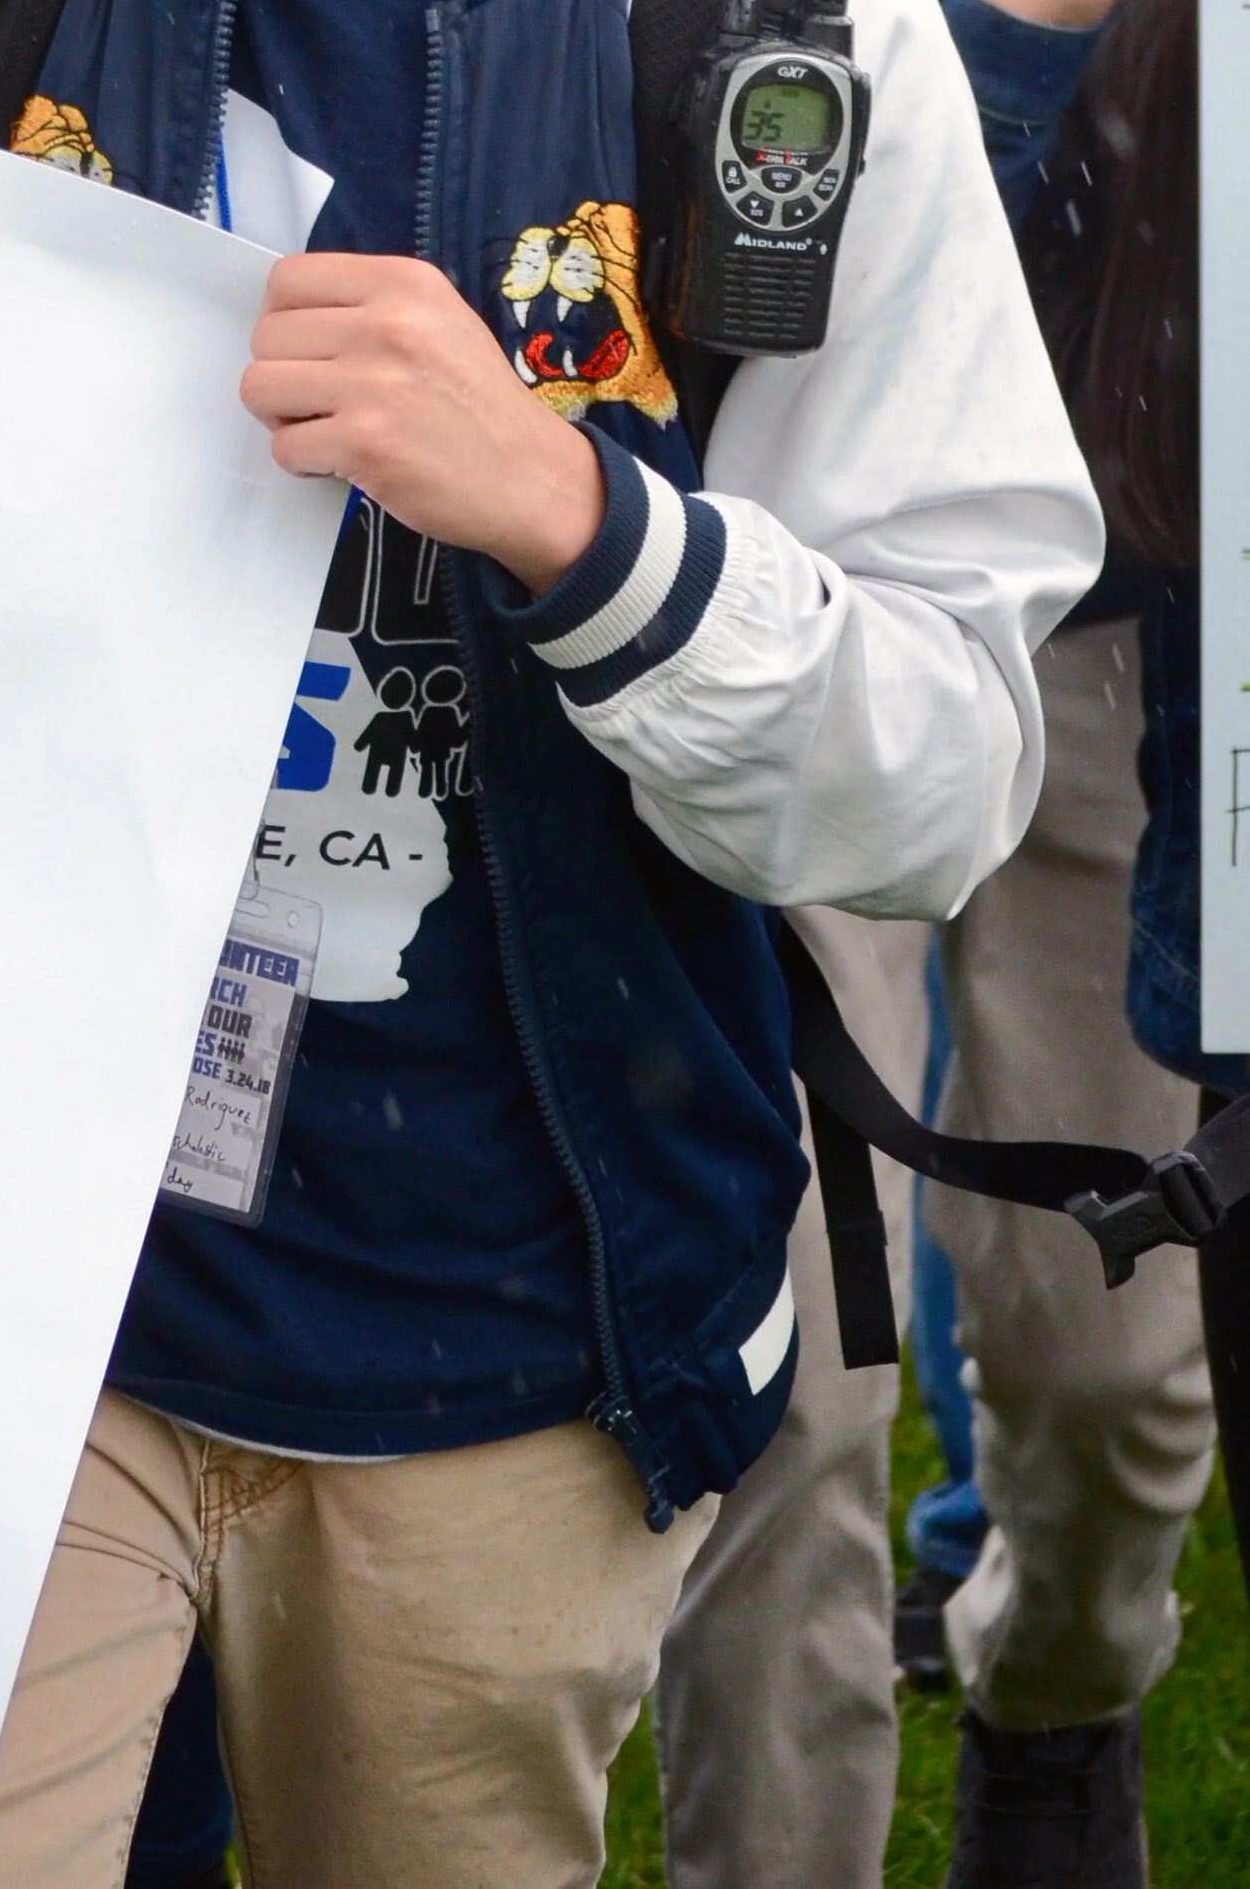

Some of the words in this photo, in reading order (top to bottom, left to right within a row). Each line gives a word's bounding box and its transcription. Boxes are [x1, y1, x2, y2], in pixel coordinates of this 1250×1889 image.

[777, 65, 809, 80] GXT
[745, 110, 785, 143] 35
[734, 231, 807, 252] MIDLAND
[319, 828, 391, 873] CA
[207, 1006, 254, 1039] OUR
[191, 1057, 223, 1081] OSE
[224, 1068, 272, 1096] 3.24.18
